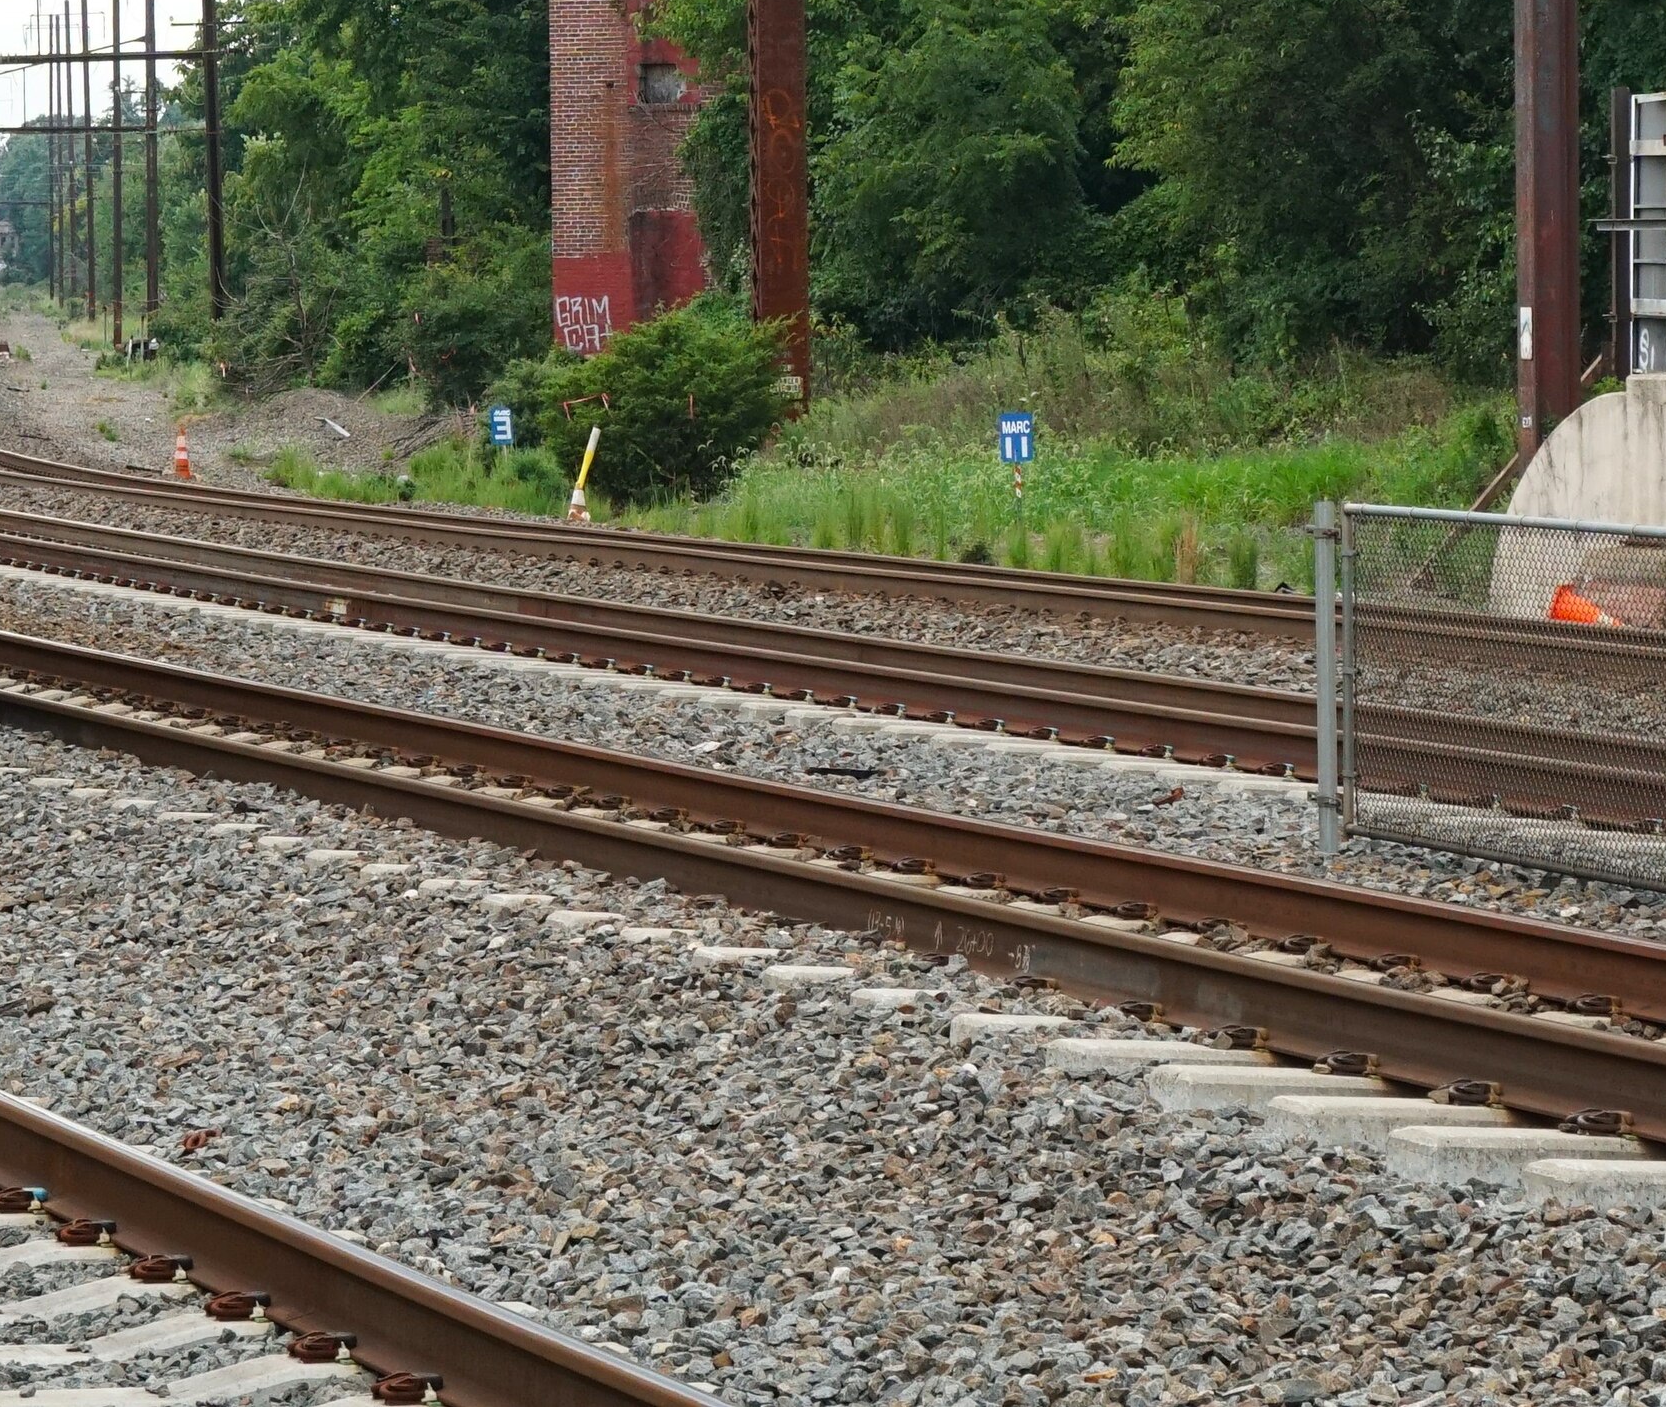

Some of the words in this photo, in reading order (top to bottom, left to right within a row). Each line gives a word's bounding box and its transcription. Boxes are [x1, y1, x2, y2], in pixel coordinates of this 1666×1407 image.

[556, 295, 611, 327] GRIM
[494, 416, 512, 440] 3
[1002, 420, 1031, 434] MARC
